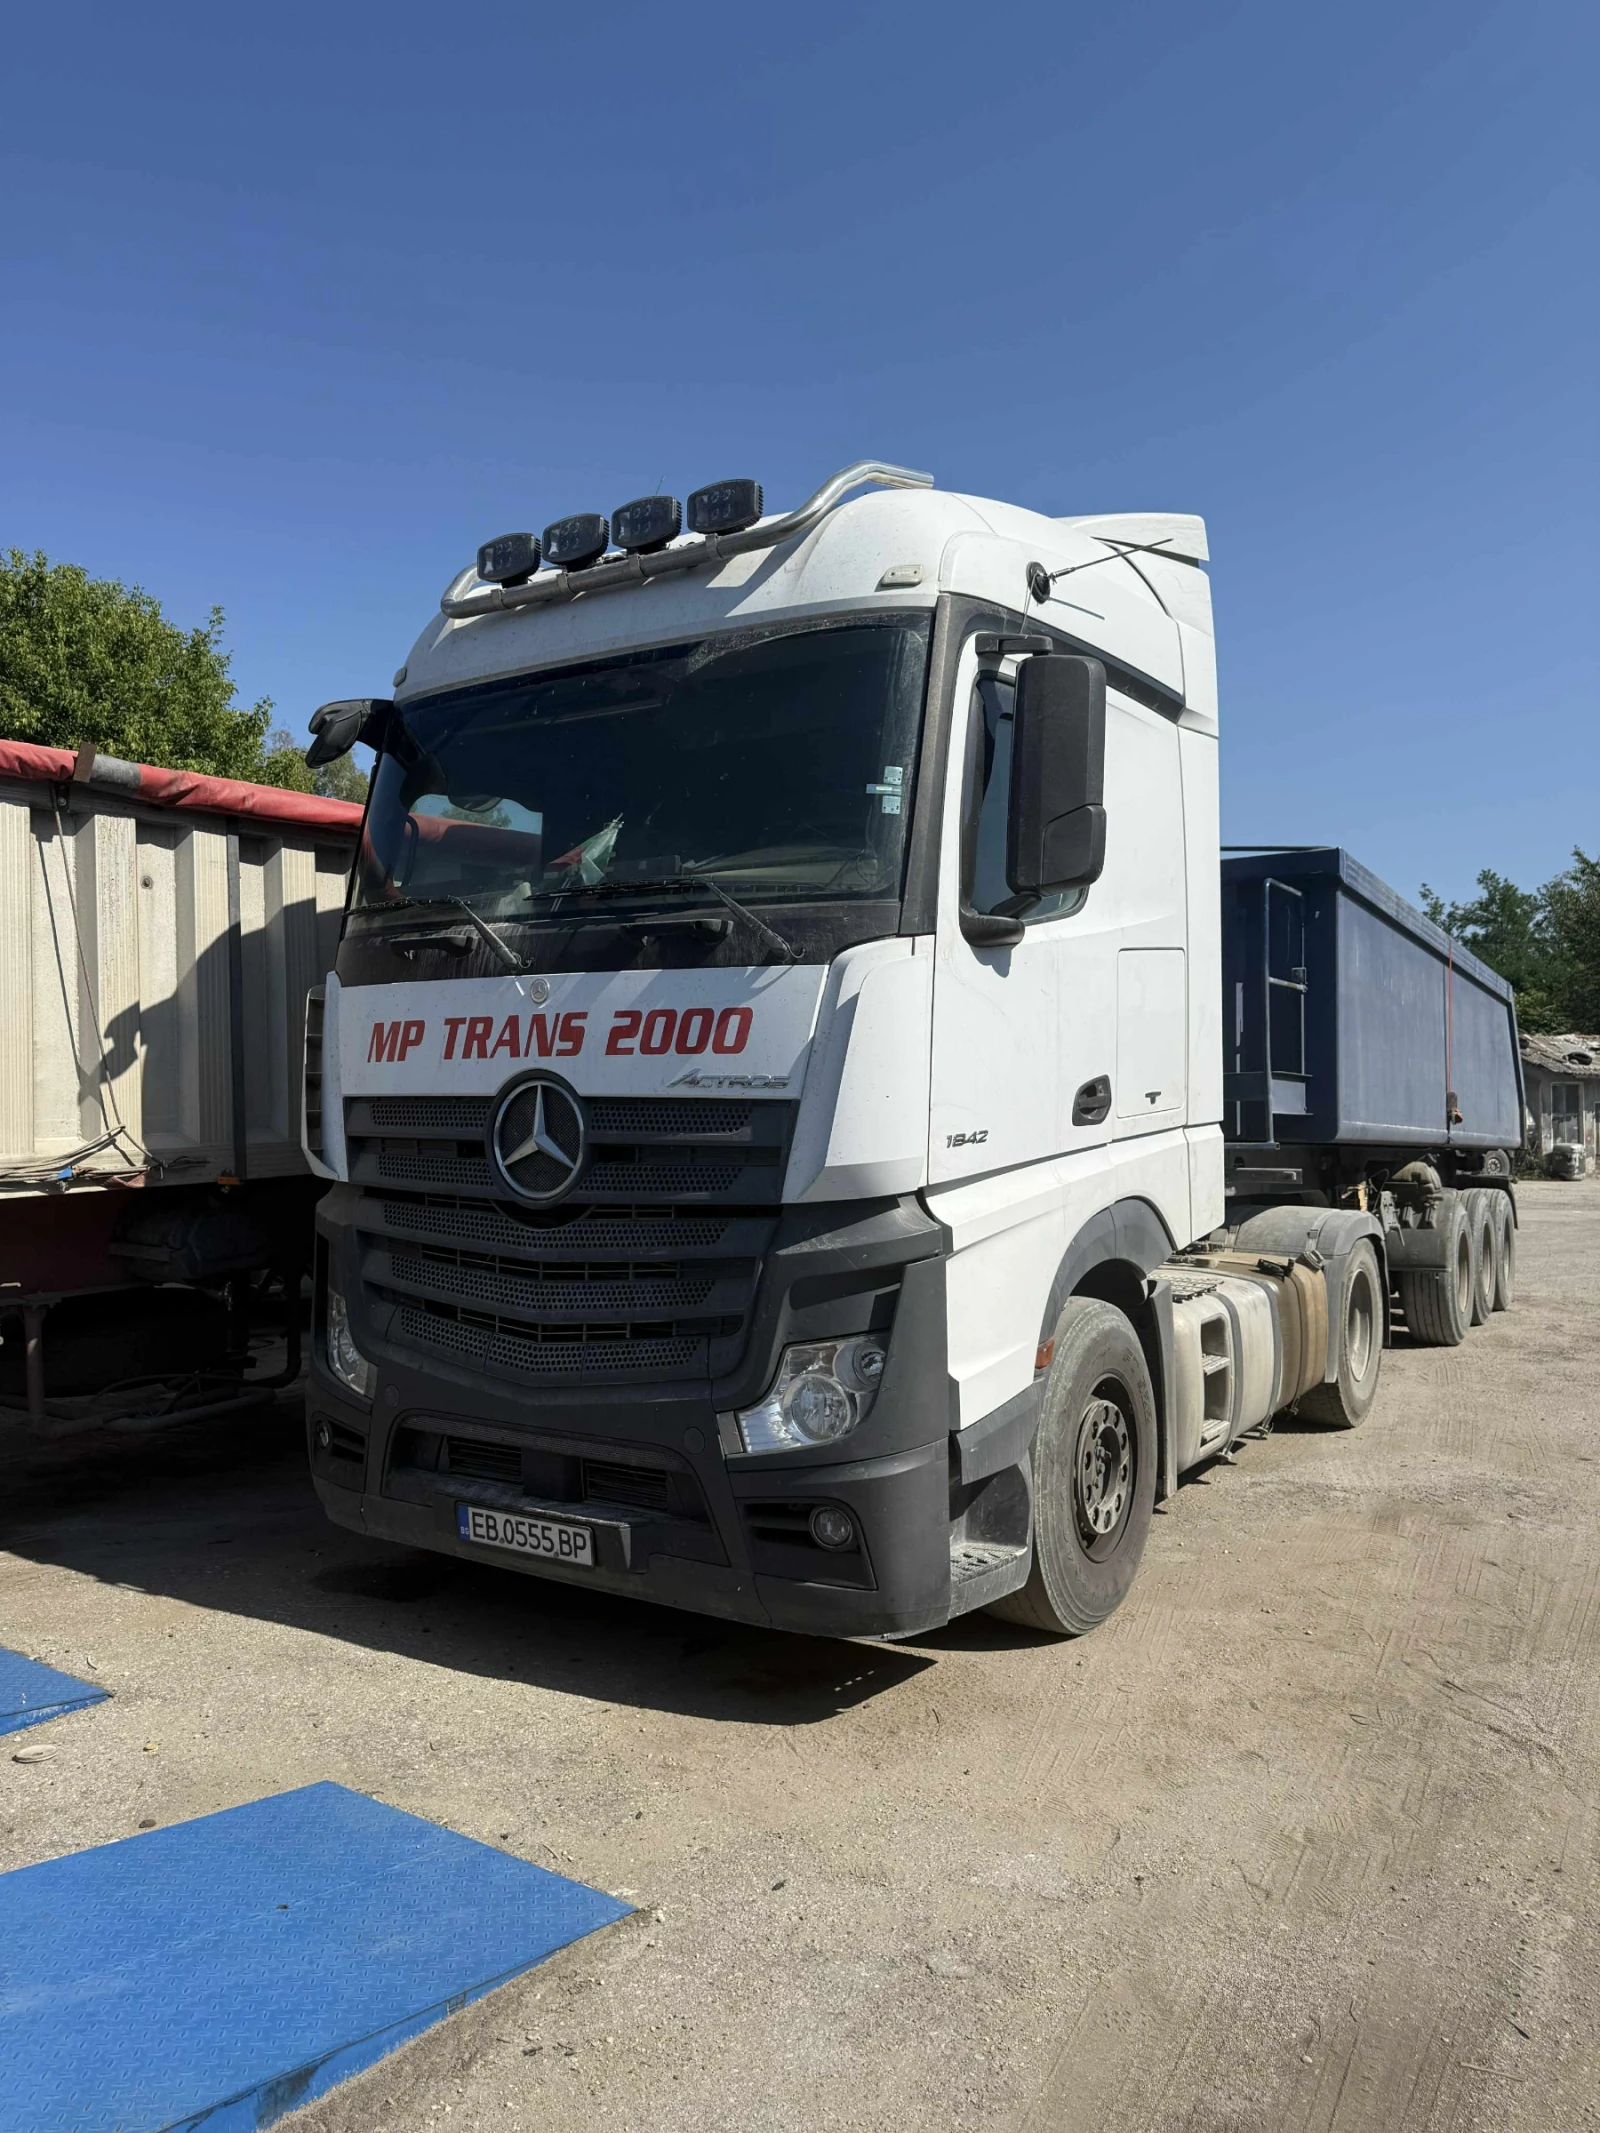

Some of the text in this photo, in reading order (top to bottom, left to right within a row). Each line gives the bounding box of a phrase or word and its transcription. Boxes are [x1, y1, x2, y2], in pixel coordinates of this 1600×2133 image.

[367, 1007, 753, 1063] MP TRANS 2000
[946, 1129, 989, 1149] 1842
